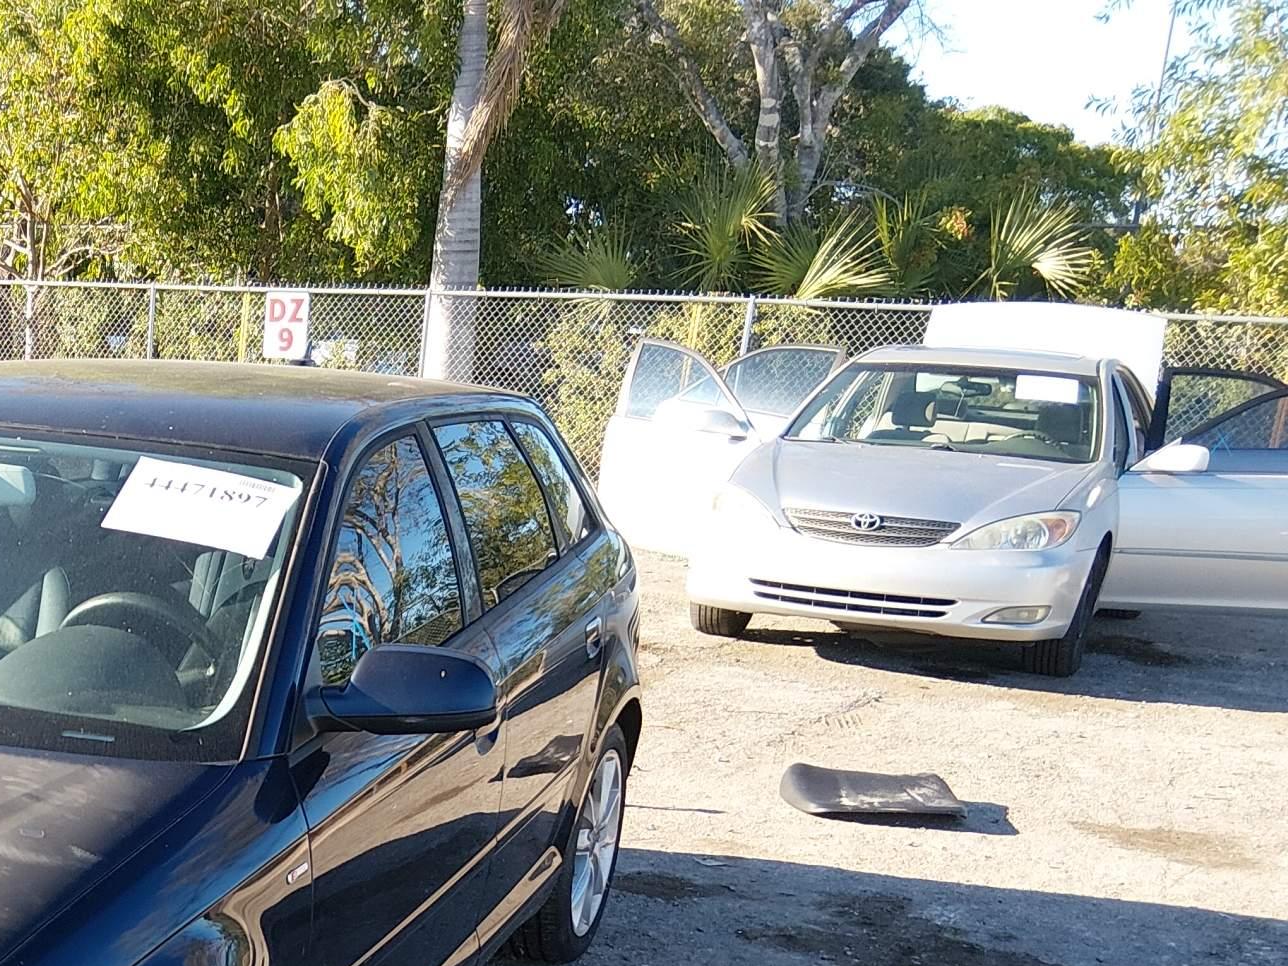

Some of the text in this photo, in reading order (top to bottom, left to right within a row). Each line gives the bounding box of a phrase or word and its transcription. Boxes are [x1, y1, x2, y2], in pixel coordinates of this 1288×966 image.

[269, 298, 304, 322] DZ
[279, 327, 293, 351] 9
[145, 476, 268, 507] 44471897
